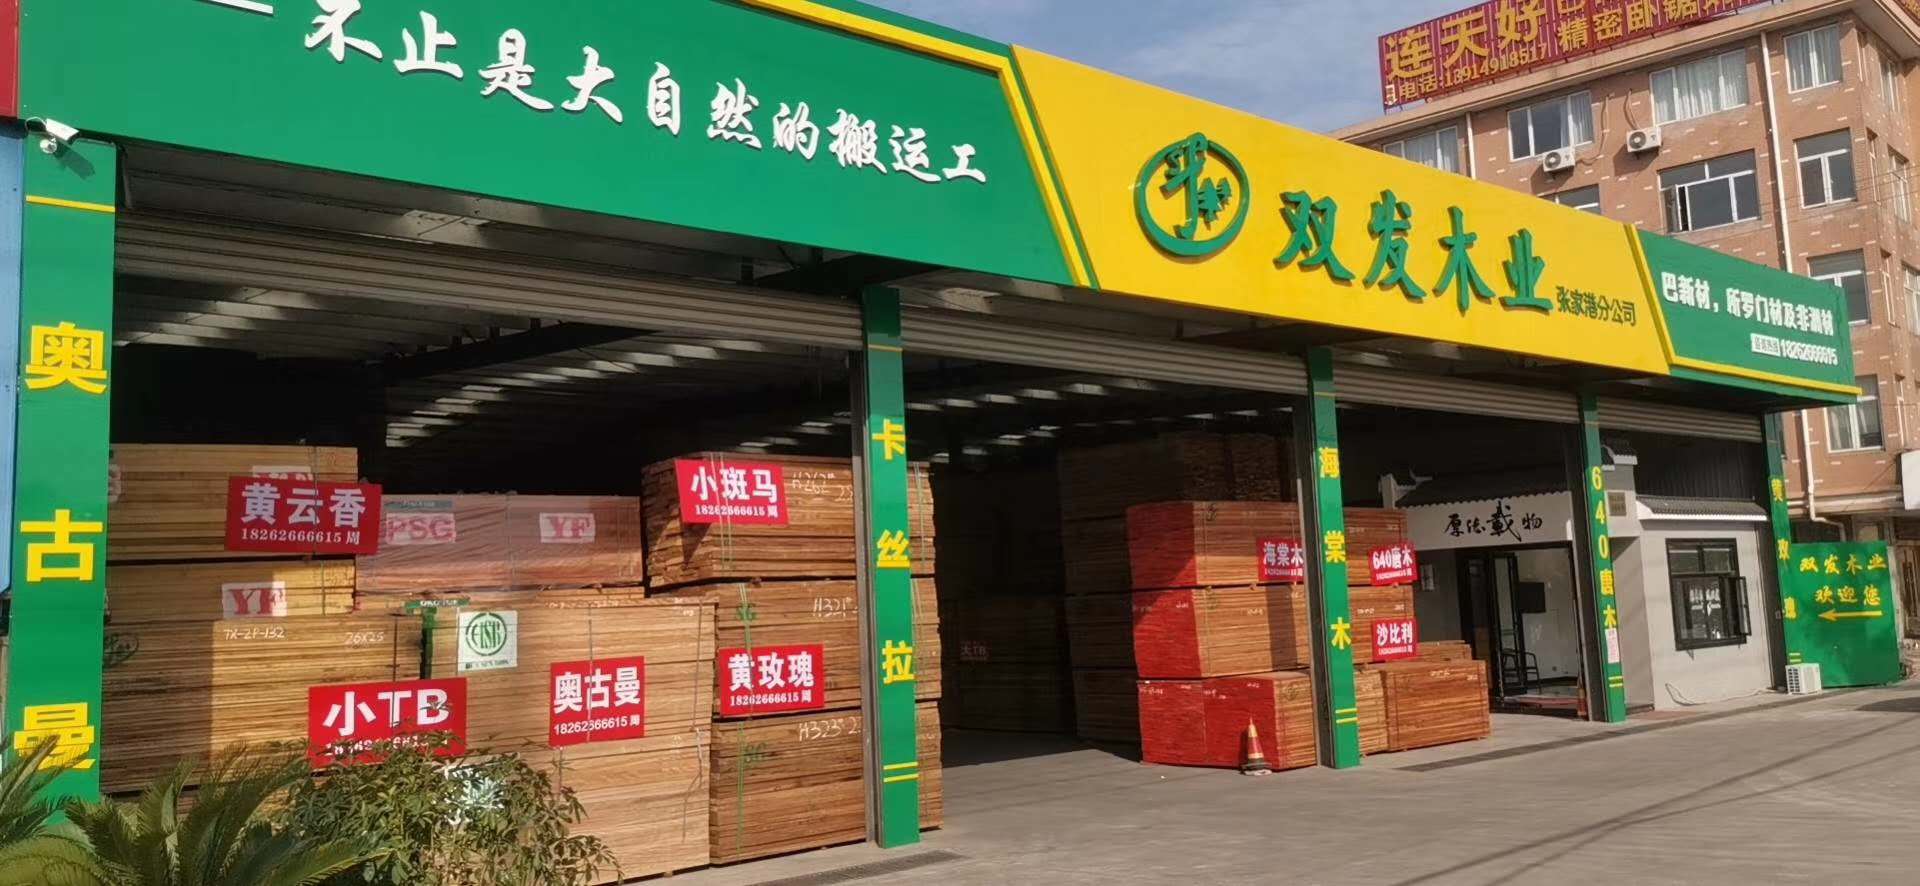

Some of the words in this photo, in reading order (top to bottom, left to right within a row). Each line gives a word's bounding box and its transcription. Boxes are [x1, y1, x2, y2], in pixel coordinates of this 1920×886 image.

[1274, 189, 1554, 315] 双发木业
[1556, 285, 1636, 327] 张家港分公司
[241, 482, 366, 528] 黄云香
[691, 466, 777, 503] 小斑马
[241, 528, 341, 544] 18262666615
[872, 418, 915, 684] 卡丝拉
[1263, 542, 1304, 566] 海棠木
[1377, 621, 1412, 646] 沙比利
[554, 667, 641, 714] 奥古曼
[728, 651, 814, 691] 黄玫瑰
[322, 689, 450, 736] 小TB
[554, 716, 628, 735] 18262666615
